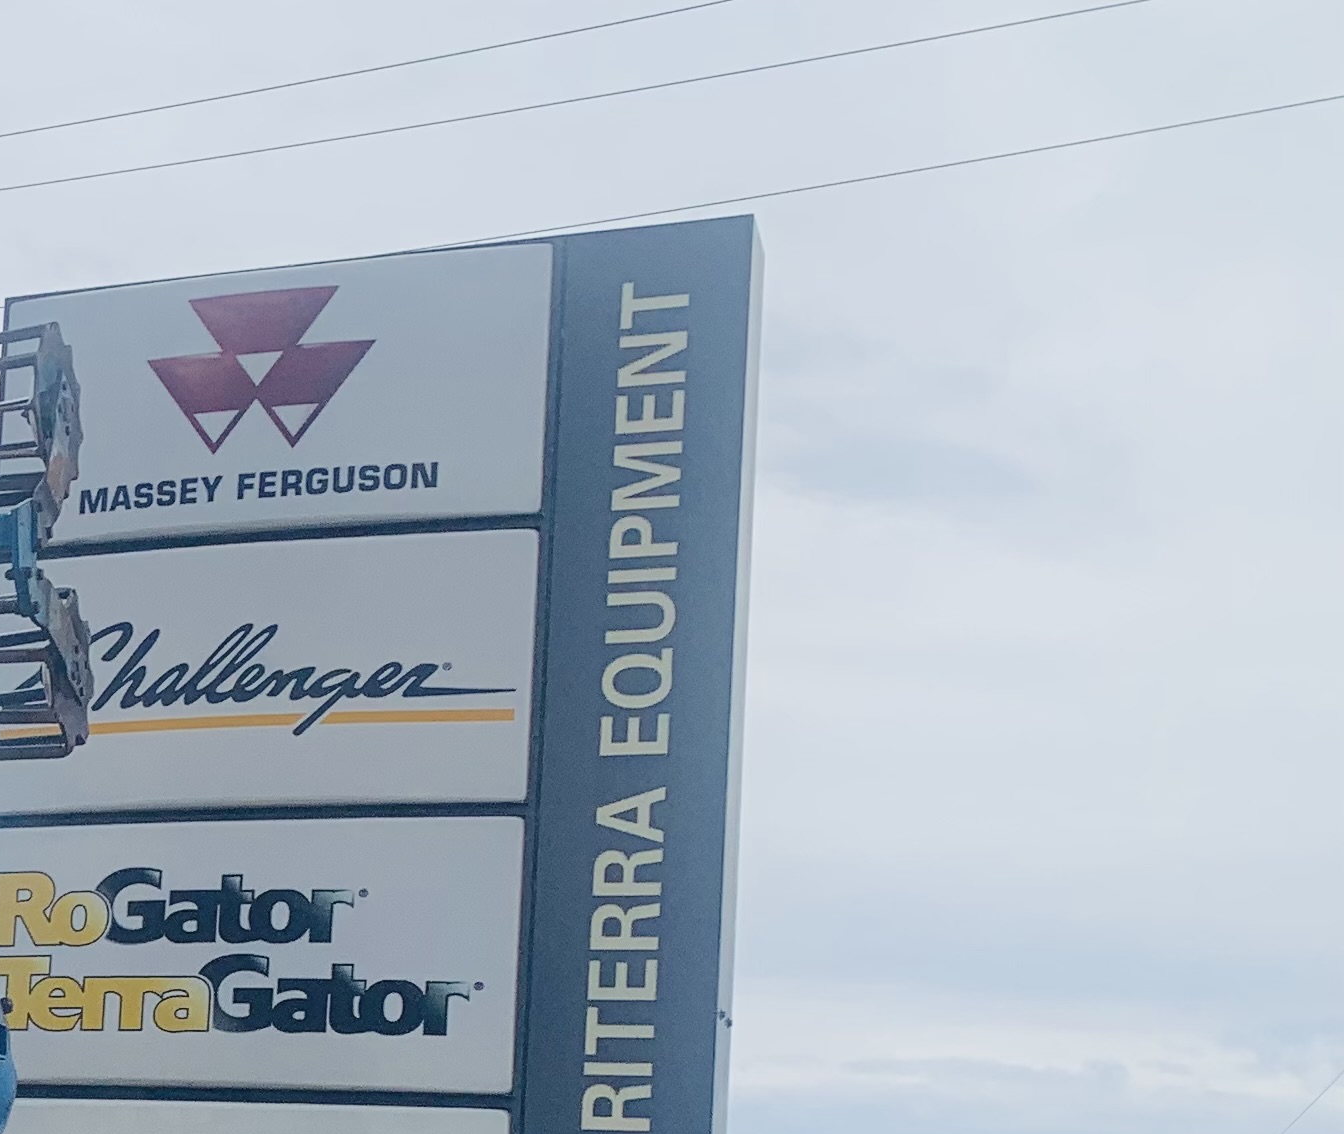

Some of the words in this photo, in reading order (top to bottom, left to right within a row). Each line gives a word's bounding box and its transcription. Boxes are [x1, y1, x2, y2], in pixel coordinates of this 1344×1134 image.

[78, 475, 225, 515] MASSEY
[236, 461, 440, 501] FERGUSON
[599, 281, 691, 758] EQUIPMENT
[89, 622, 516, 736] Challenger
